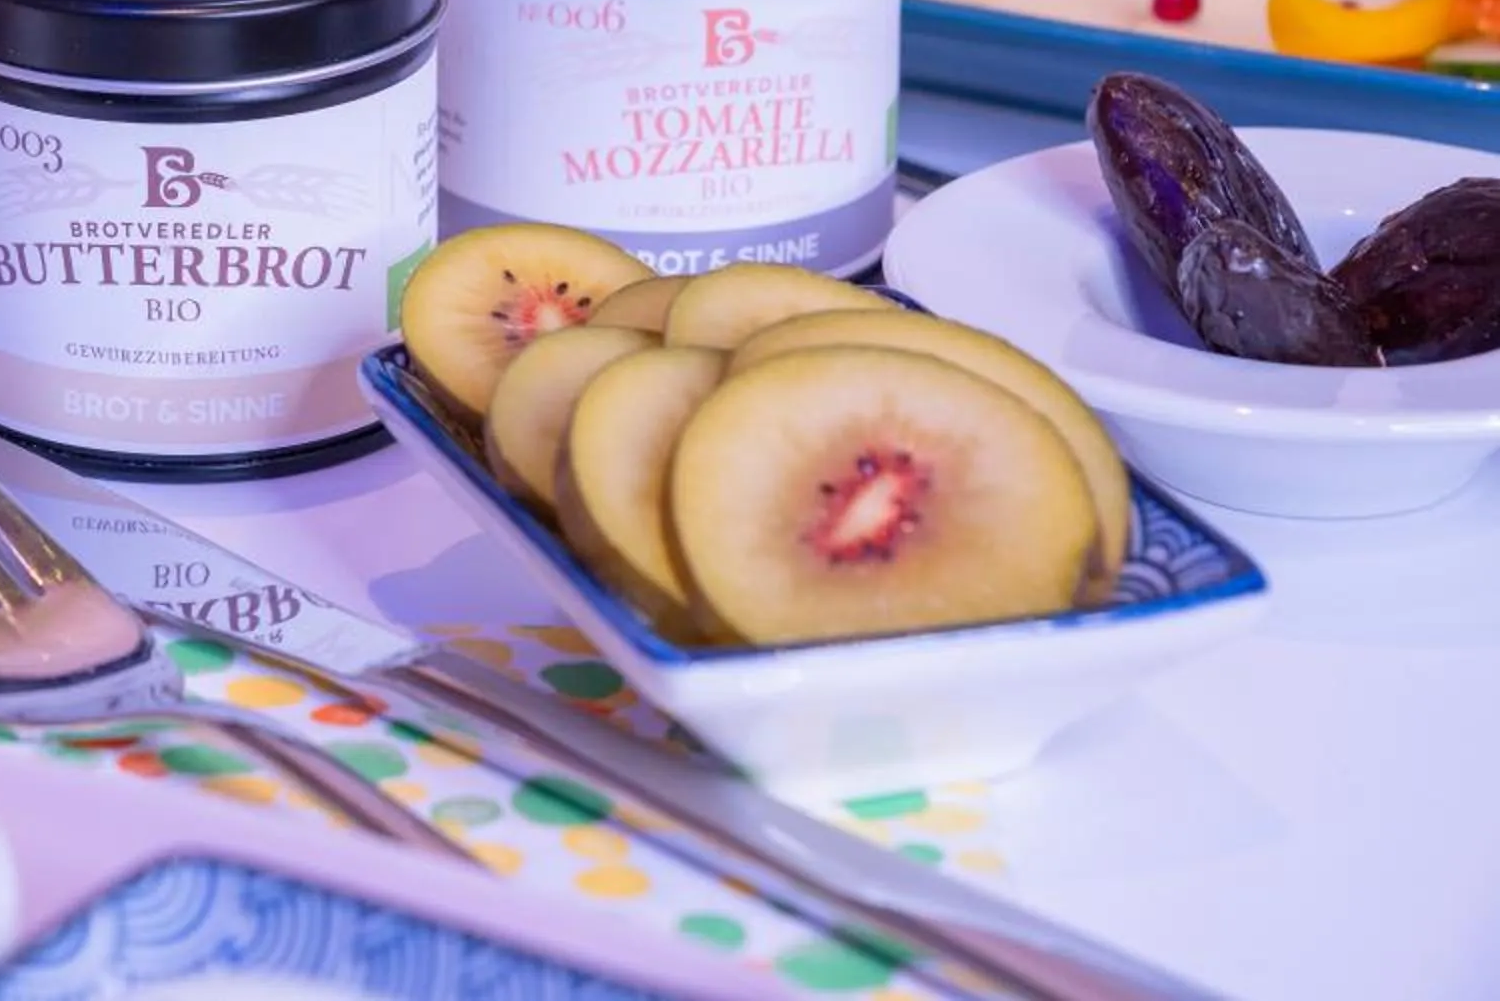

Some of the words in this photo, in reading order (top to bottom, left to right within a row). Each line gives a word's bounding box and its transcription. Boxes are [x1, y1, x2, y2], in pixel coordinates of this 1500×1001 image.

[625, 73, 814, 105] BROTVEREDLER
[621, 95, 815, 143] TOMATE
[561, 127, 856, 186] MOZZARELLA
[700, 172, 754, 201] BIO
[69, 221, 273, 241] BROTVEREDLER
[144, 297, 202, 322] BIO
[63, 388, 150, 424] BROT
[155, 399, 182, 426] &
[188, 392, 289, 426] SINNE
